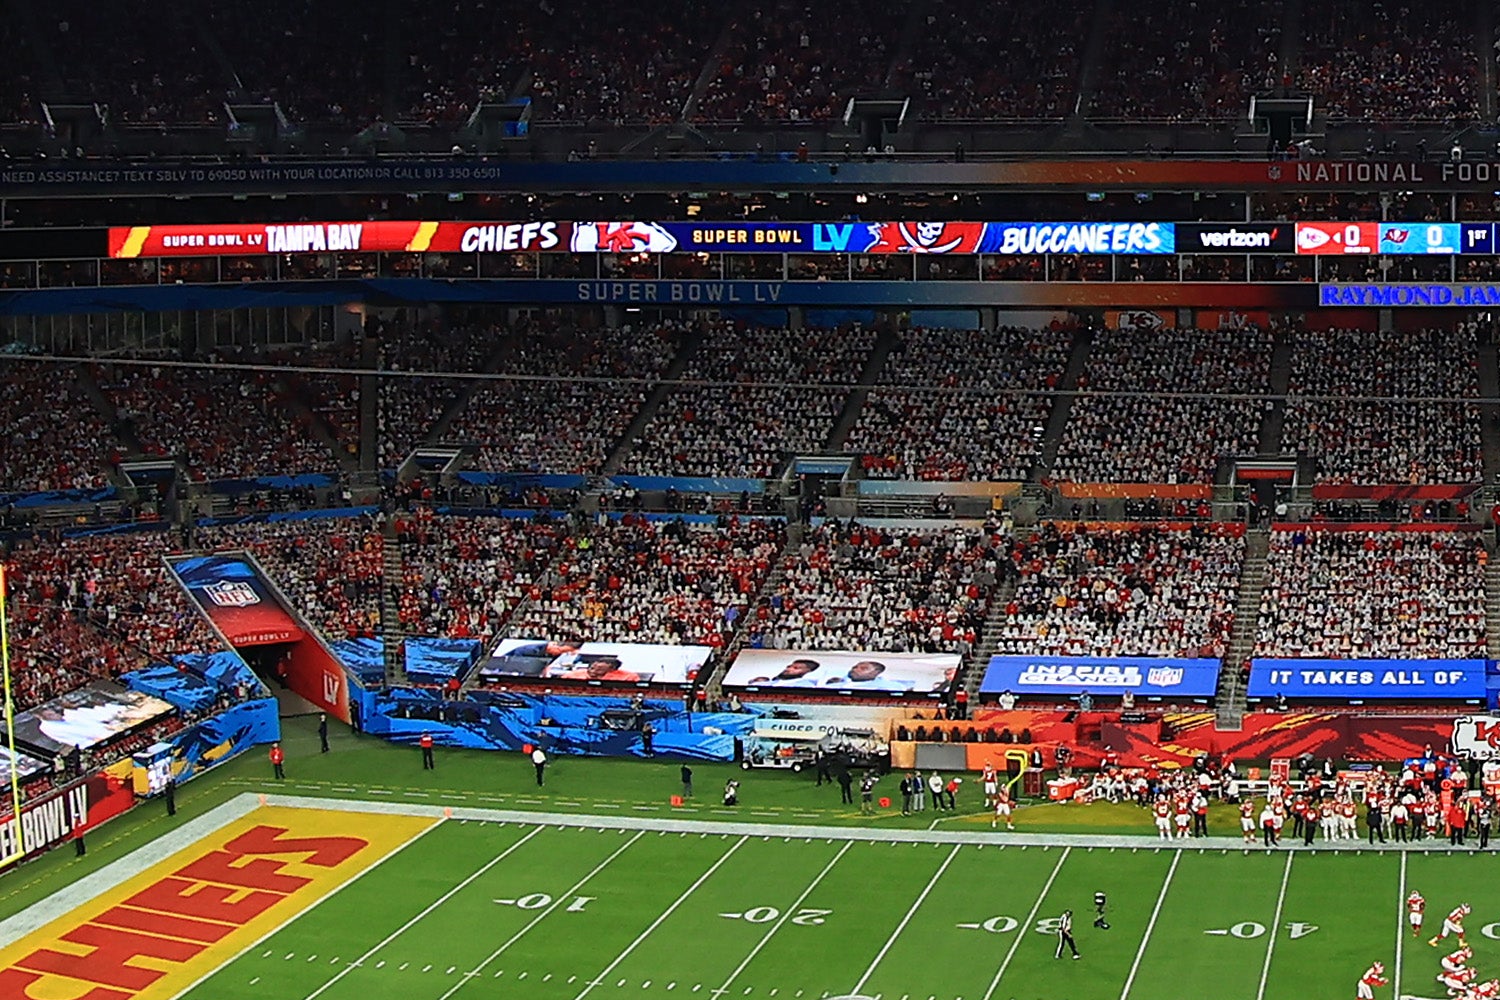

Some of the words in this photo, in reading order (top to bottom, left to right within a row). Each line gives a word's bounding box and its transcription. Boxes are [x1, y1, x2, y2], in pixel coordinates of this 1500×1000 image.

[2, 171, 35, 183] NEED
[38, 170, 119, 182] ASSISTANCE?
[123, 170, 153, 182] TEXT
[156, 170, 187, 182] SBLV
[191, 170, 205, 182] TO
[250, 168, 280, 180] WITH
[283, 168, 316, 180] YOUR
[318, 168, 374, 180] LOCATION
[375, 168, 391, 179] OR
[394, 168, 421, 179] CALL
[1297, 163, 1424, 182] NATIONAL
[163, 235, 204, 247] SUPER
[208, 235, 244, 246] BOWL
[247, 234, 263, 246] LV
[265, 224, 326, 253] TAMPA
[327, 223, 363, 251] BAY
[460, 222, 560, 253] CHIEFS
[692, 229, 748, 244] SUPER
[754, 229, 803, 244] BOWL
[812, 223, 854, 251] LV
[999, 223, 1161, 253] BUCCANEERS
[1199, 228, 1271, 247] verizon
[1344, 225, 1361, 247] 0
[1426, 225, 1443, 247] 0
[1467, 229, 1488, 248] 1ST
[578, 283, 658, 301] SUPER
[671, 283, 741, 301] BOWL
[753, 283, 782, 301] LV
[1320, 285, 1453, 306] RAYMOND
[233, 635, 257, 644] SUPER
[259, 633, 278, 641] BOWL
[280, 632, 290, 640] LV
[323, 669, 340, 706] LV
[1270, 670, 1293, 685] IT
[1301, 670, 1375, 685] TAKES
[1381, 671, 1426, 686] ALL
[1434, 671, 1464, 685] OF
[21, 794, 70, 854] BOWL
[515, 893, 597, 913] 10
[743, 906, 833, 926] 20
[1229, 921, 1320, 940] 40
